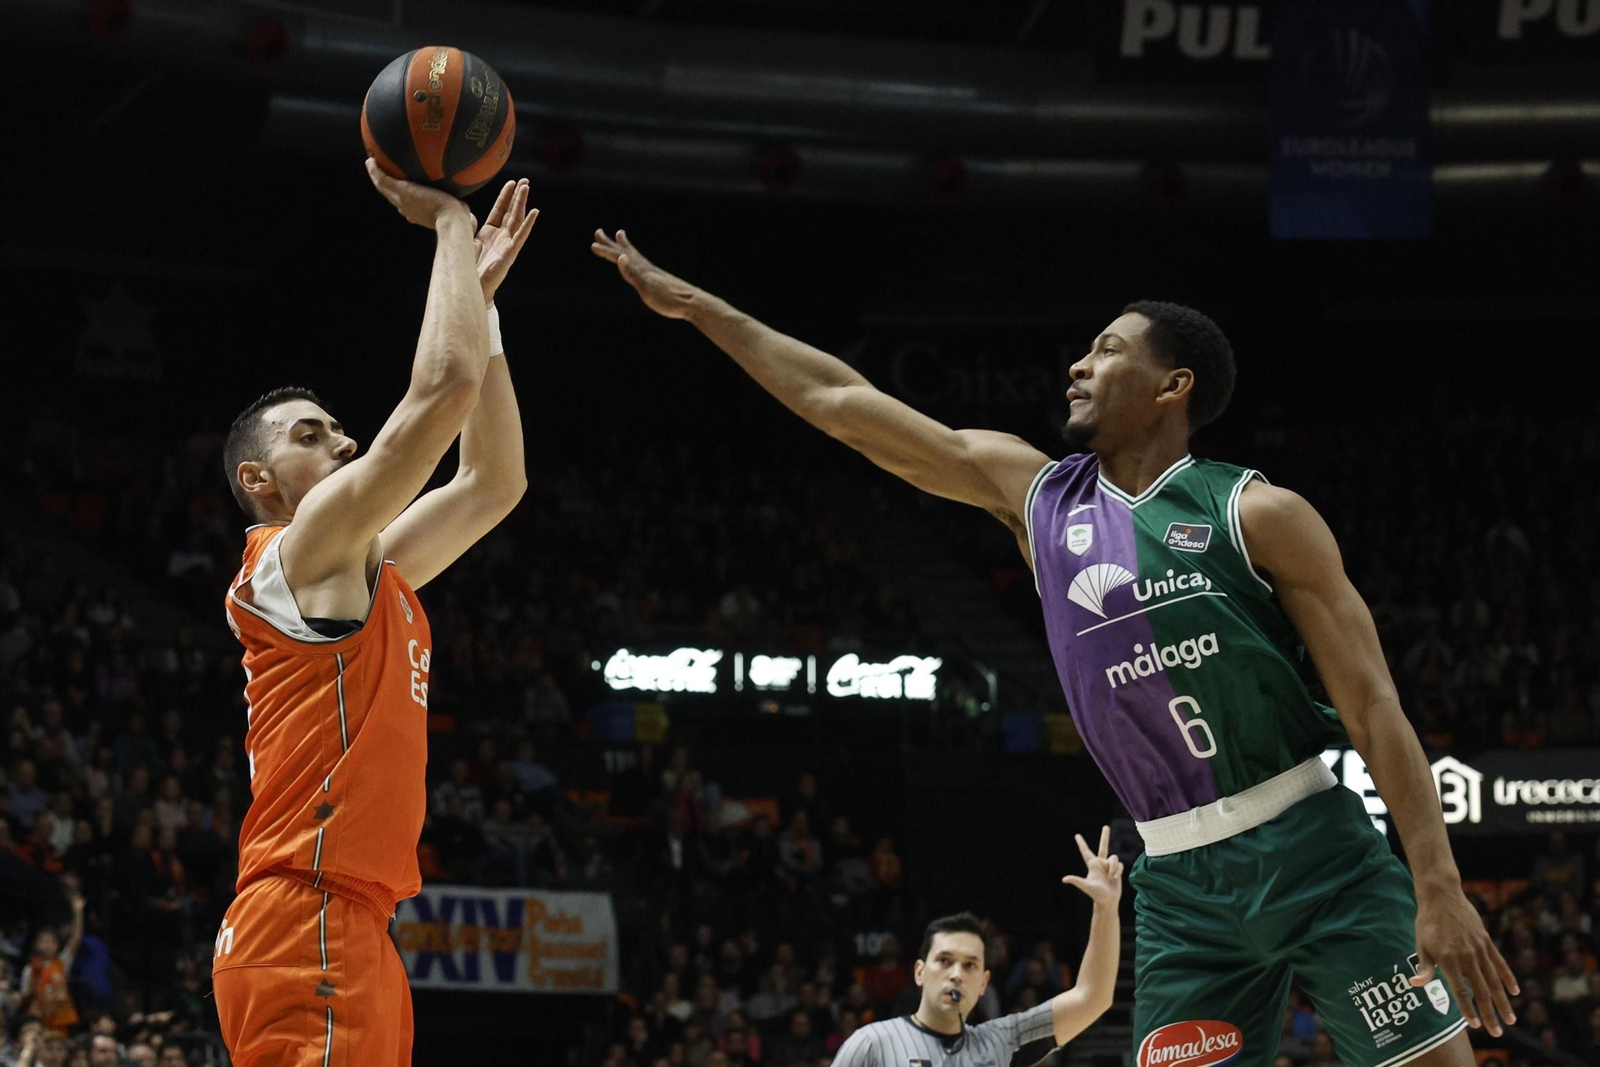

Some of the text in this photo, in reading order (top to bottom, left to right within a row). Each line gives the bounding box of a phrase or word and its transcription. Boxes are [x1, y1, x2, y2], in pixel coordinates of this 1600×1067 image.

[1119, 0, 1272, 61] PUL
[1168, 538, 1205, 549] endesa
[1170, 530, 1188, 541] liga
[1168, 695, 1218, 759] 6
[1348, 976, 1374, 997] sabor
[1352, 995, 1363, 1007] a
[1145, 1025, 1239, 1067] famadesa
